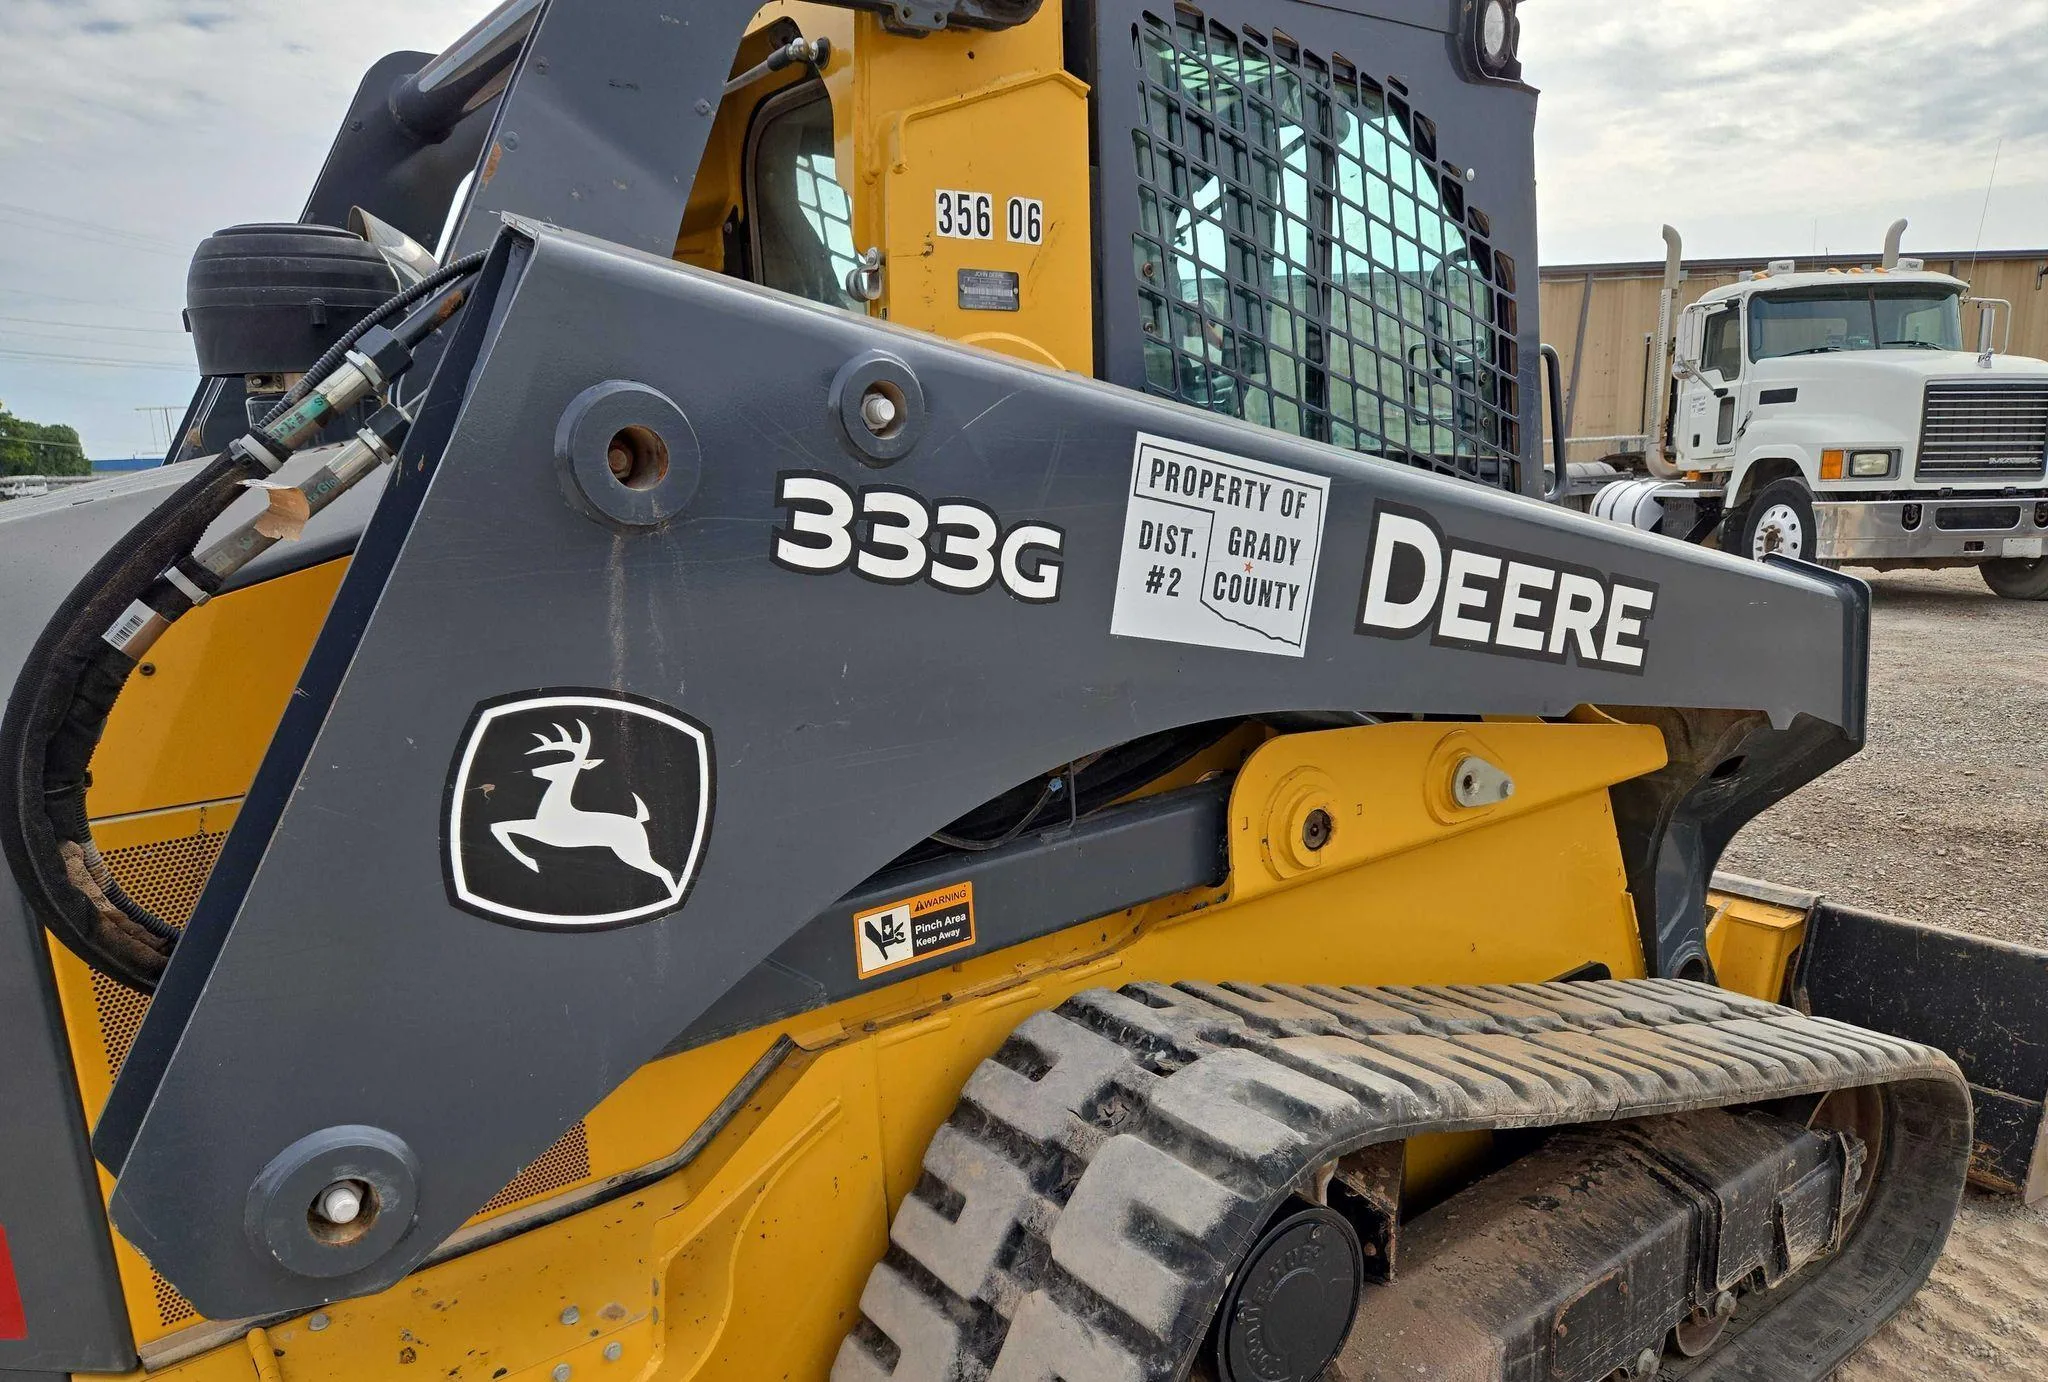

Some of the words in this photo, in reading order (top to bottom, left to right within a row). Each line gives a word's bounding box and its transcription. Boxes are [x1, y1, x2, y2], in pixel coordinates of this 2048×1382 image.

[938, 193, 991, 237] 356
[1010, 199, 1041, 243] 06
[1149, 458, 1272, 512] PROPERTY
[1280, 488, 1307, 519] OF
[776, 477, 1062, 599] 333G
[1138, 520, 1197, 559] DIST.
[1228, 526, 1301, 566] GRADY
[1145, 564, 1182, 597] #2
[1212, 571, 1300, 611] COUNTY
[1362, 511, 1654, 667] DEERE
[924, 889, 967, 909] WARNING
[915, 920, 943, 935] Pinch
[944, 912, 967, 927] Area
[915, 935, 939, 948] Keep
[938, 928, 961, 942] Away
